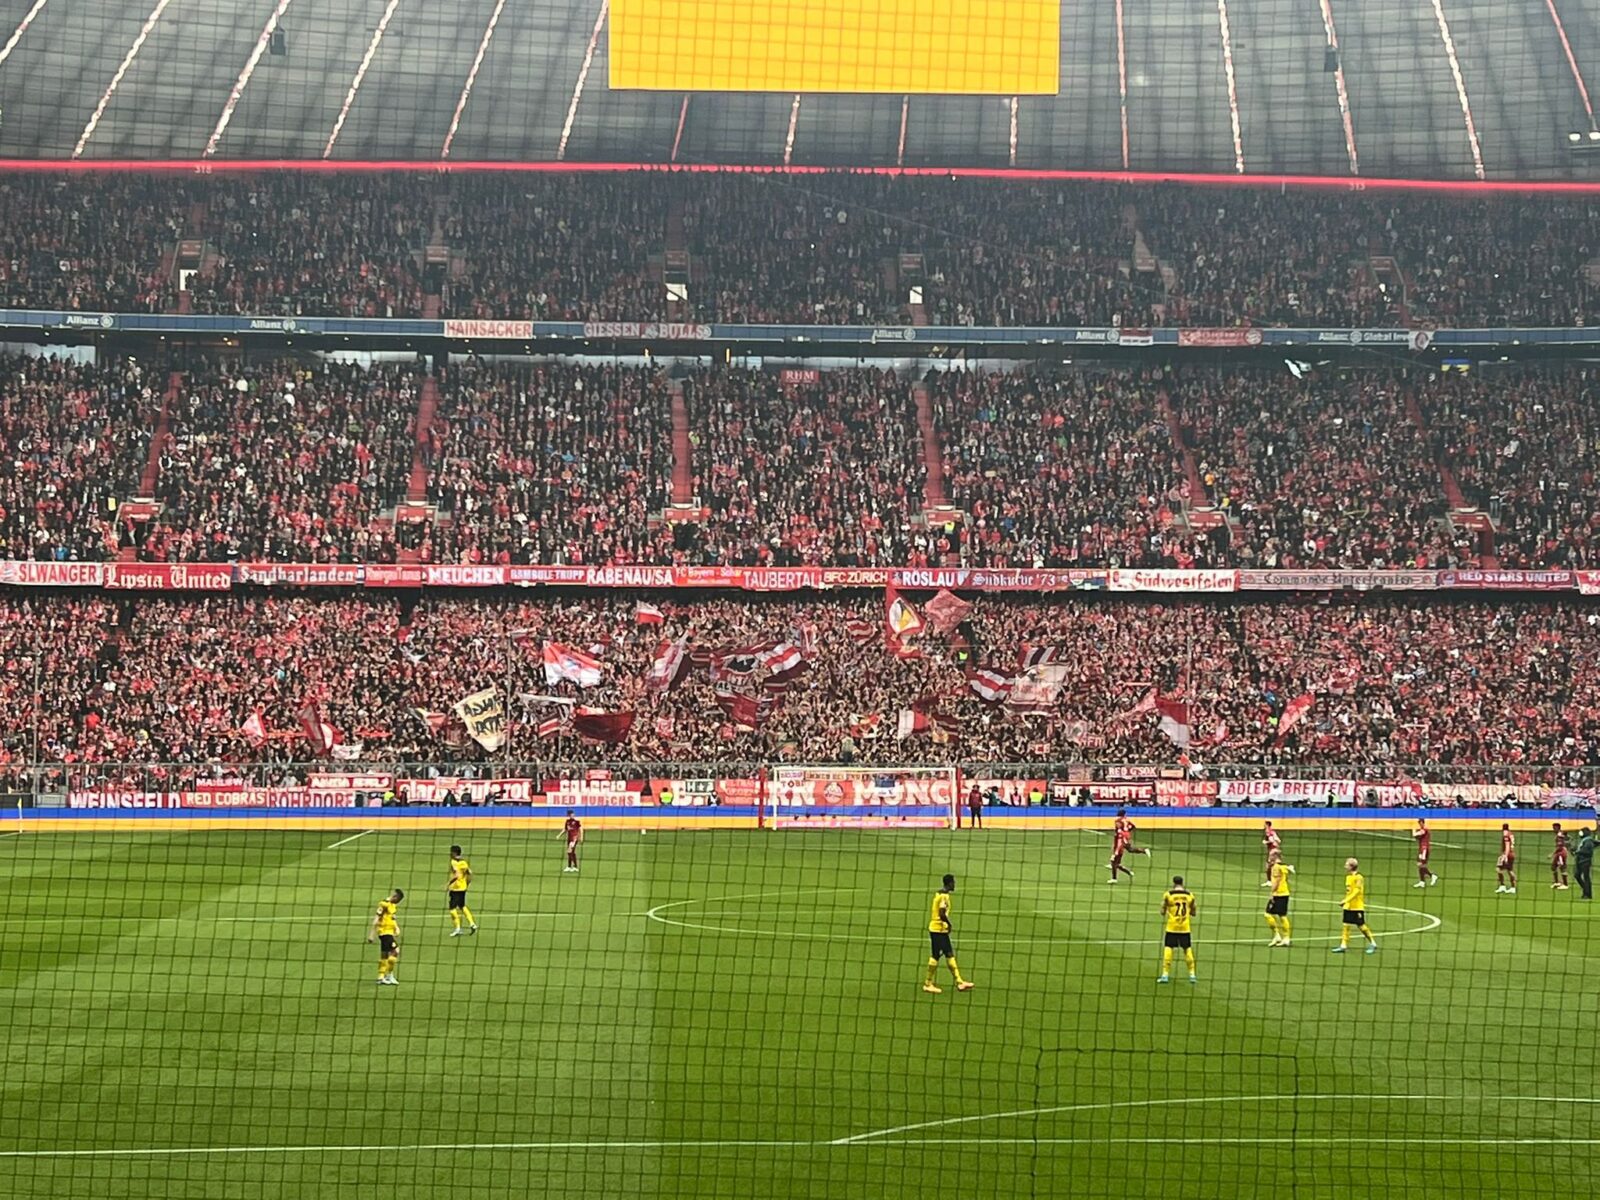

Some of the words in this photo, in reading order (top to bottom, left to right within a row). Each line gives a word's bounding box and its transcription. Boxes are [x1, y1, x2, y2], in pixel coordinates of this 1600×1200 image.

[67, 316, 99, 325] Allianz
[250, 320, 282, 329] Allianz
[446, 322, 532, 337] HAINSACKER
[584, 324, 640, 337] GIESSEN
[659, 324, 704, 338] BULLS
[873, 329, 902, 339] Allianz
[1076, 331, 1106, 340] Allianz
[1319, 332, 1348, 341] Allianz
[104, 565, 163, 588] Lipsia
[170, 566, 230, 588] United
[428, 567, 504, 584] MEUCHEN
[587, 569, 673, 585] RABENAU/SA
[743, 570, 819, 588] TAUBERTAL
[847, 570, 887, 583] ZÜRICH
[902, 569, 955, 586] RÖSLAU
[1458, 572, 1482, 581] RED
[1484, 572, 1523, 582] STARS
[1525, 572, 1570, 582] UNITED
[502, 781, 532, 801] rot
[1227, 782, 1270, 795] ADLER
[1283, 783, 1349, 795] BRETTEN
[186, 793, 211, 806] RED
[214, 792, 266, 806] COBRAS
[553, 795, 576, 805] RED
